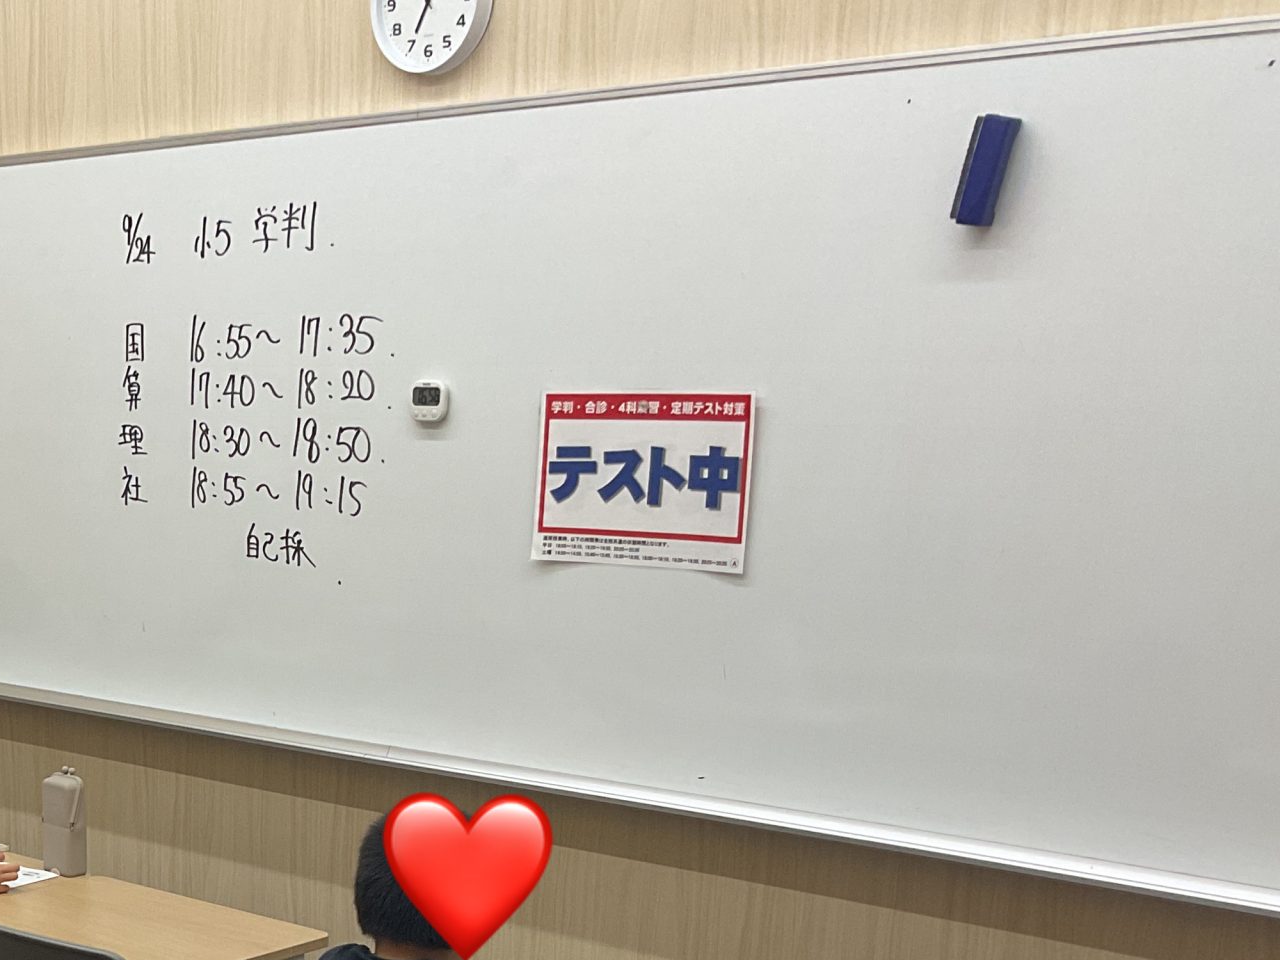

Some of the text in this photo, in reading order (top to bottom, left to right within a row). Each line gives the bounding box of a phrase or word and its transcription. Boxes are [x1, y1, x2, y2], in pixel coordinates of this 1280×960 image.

[387, 0, 396, 12] 9
[456, 14, 466, 27] 4
[392, 23, 402, 36] 8
[407, 39, 416, 53] 7
[442, 35, 452, 48] 5
[424, 45, 433, 58] 6
[118, 424, 148, 455] 理
[549, 446, 740, 510] テスト中
[121, 466, 148, 506] 社
